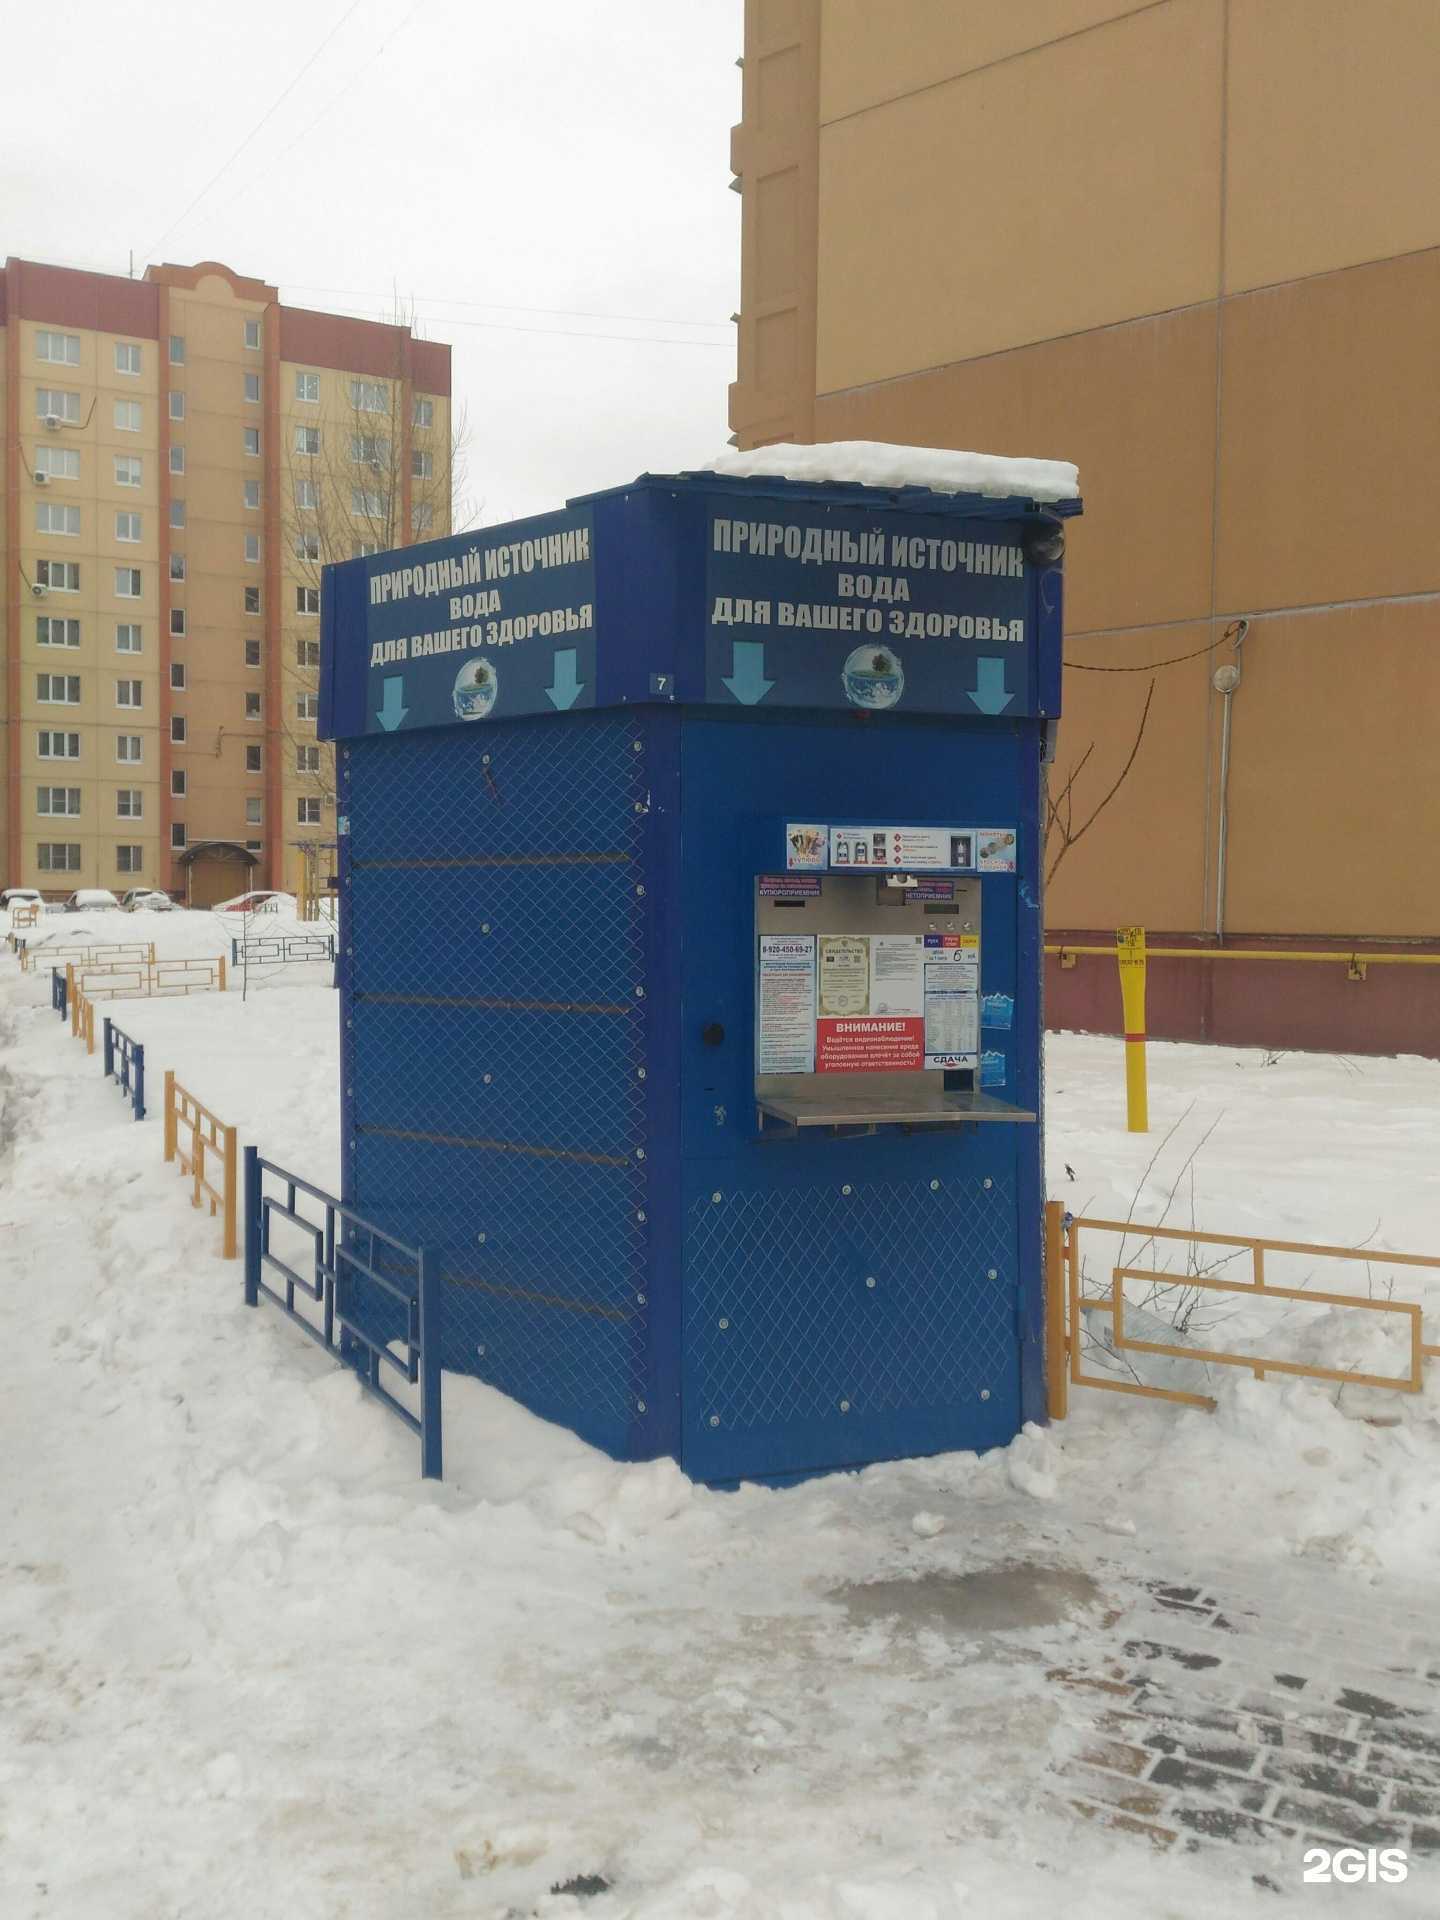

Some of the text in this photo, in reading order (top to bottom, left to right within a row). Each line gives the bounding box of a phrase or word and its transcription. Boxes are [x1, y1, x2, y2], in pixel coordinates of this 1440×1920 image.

[713, 518, 1024, 578] ПРИРОДНЫЙ ИСТОЧНИК
[370, 527, 590, 605] ПРИРОДНЫЙ ИСТОЧНИК
[838, 573, 911, 604] ВОДА
[449, 589, 501, 621] ВОДА
[711, 597, 1025, 642] ДЛЯ ВАШЕГО ЗДОРОВЬЯ
[370, 604, 593, 668] ДЛЯ ВАШЕГО ЗДОРОВЬЯ
[657, 677, 666, 690] 7
[836, 1022, 906, 1033] ВНИМАНИЕ!
[933, 1056, 968, 1064] СДАЧА
